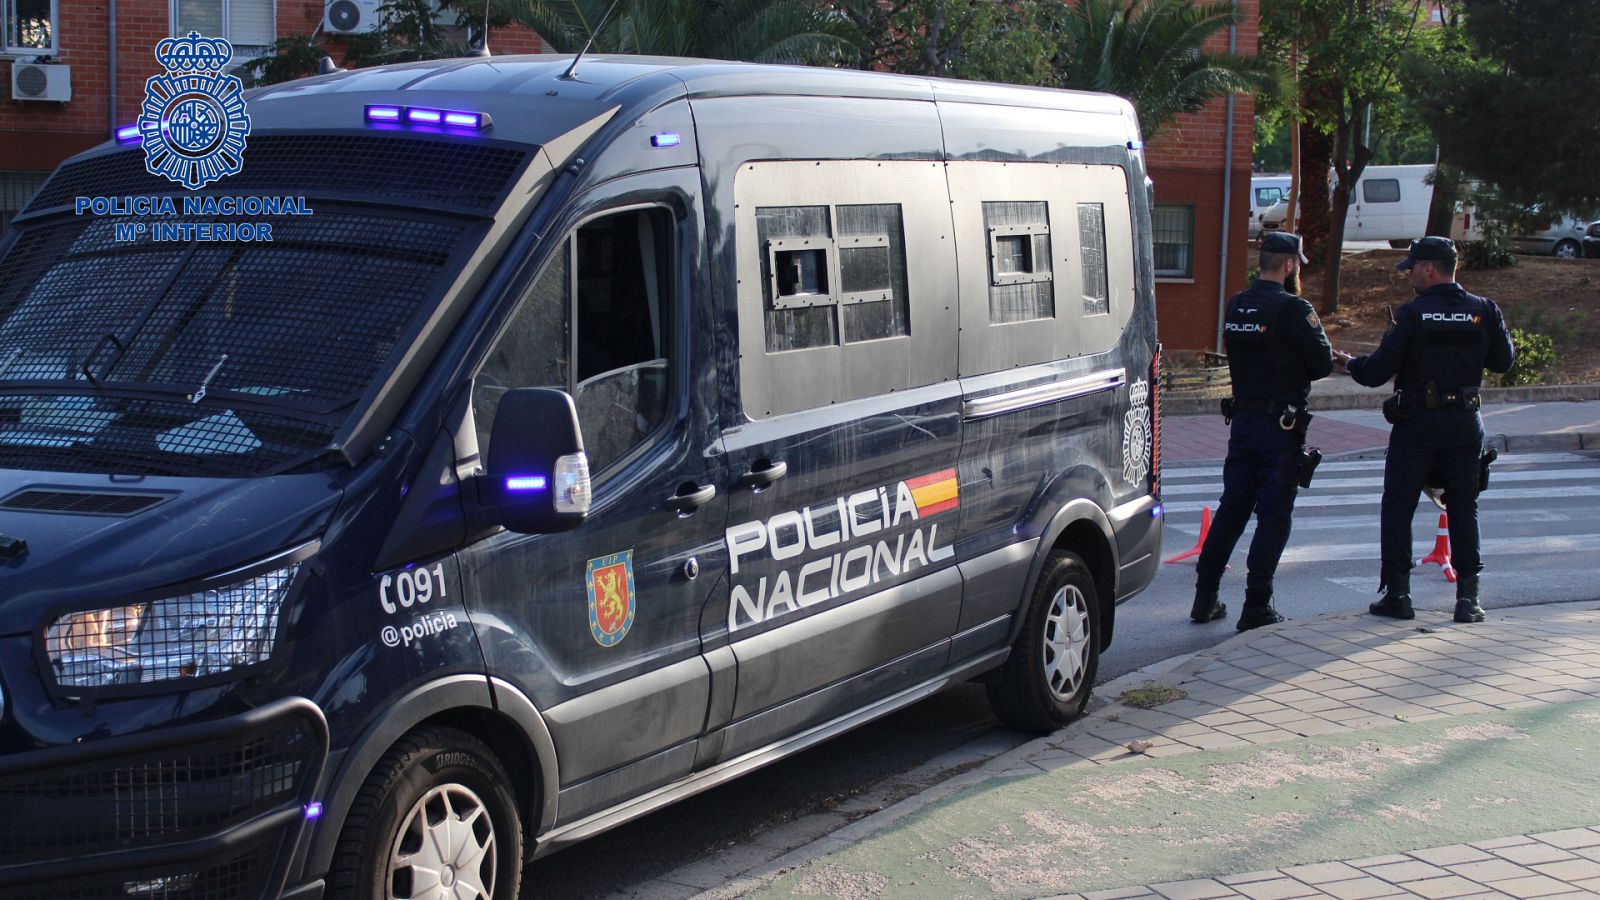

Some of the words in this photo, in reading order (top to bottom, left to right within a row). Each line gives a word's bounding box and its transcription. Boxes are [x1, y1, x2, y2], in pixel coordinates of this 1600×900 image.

[1225, 322, 1261, 332] POLICIA
[1422, 312, 1474, 322] POLICIA
[396, 562, 447, 608] 091
[728, 523, 955, 633] NACIONAL
[381, 611, 458, 648] @policia
